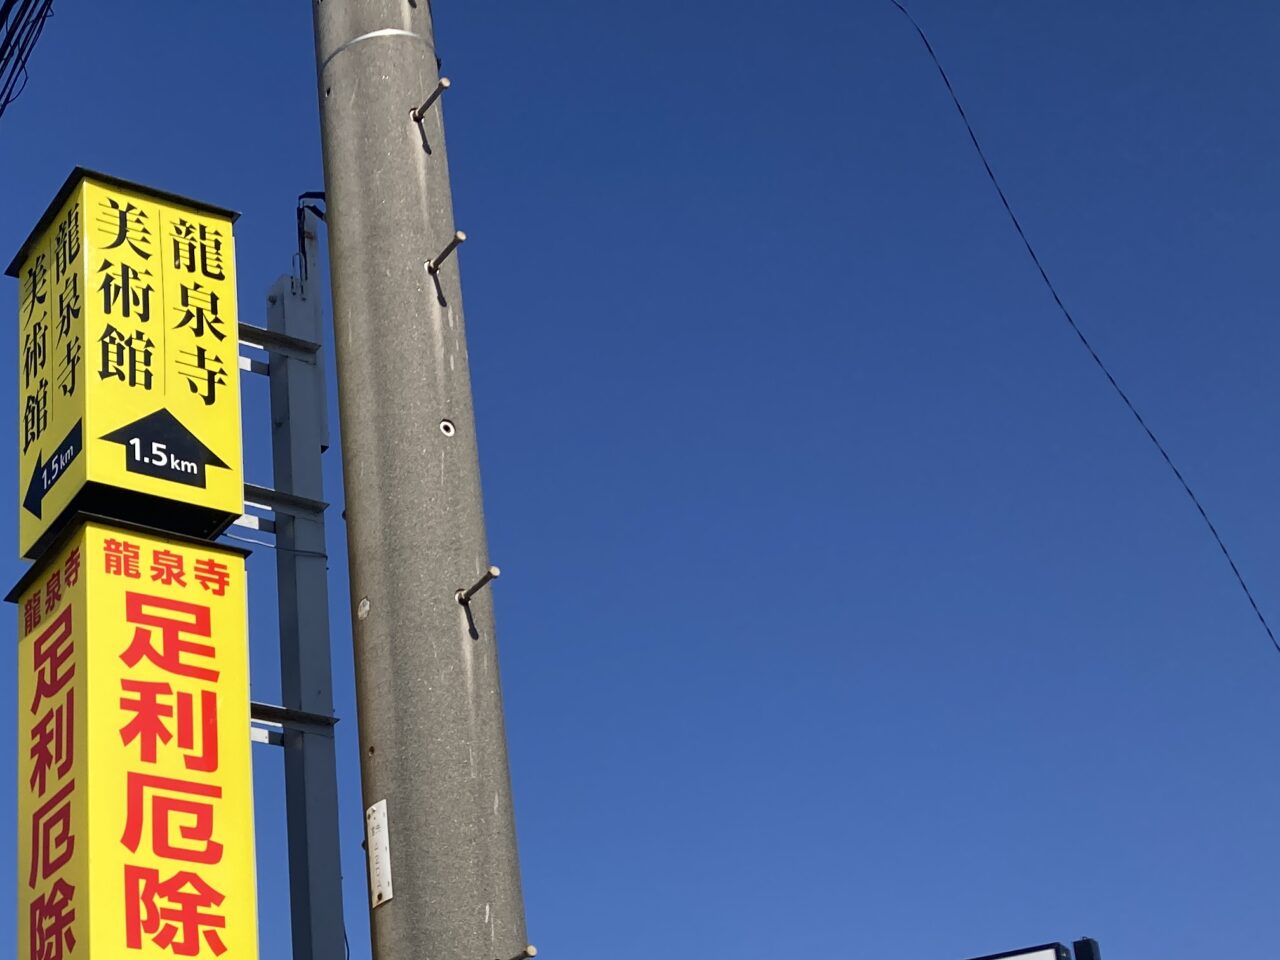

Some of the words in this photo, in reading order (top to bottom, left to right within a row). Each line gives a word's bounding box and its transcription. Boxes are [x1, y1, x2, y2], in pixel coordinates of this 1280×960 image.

[23, 252, 48, 456] 美術館
[55, 203, 82, 397] 龍泉寺
[96, 197, 155, 392] 美術館
[170, 217, 227, 406] 龍泉寺
[24, 546, 81, 634] 龍泉寺
[103, 538, 231, 597] 龍泉寺
